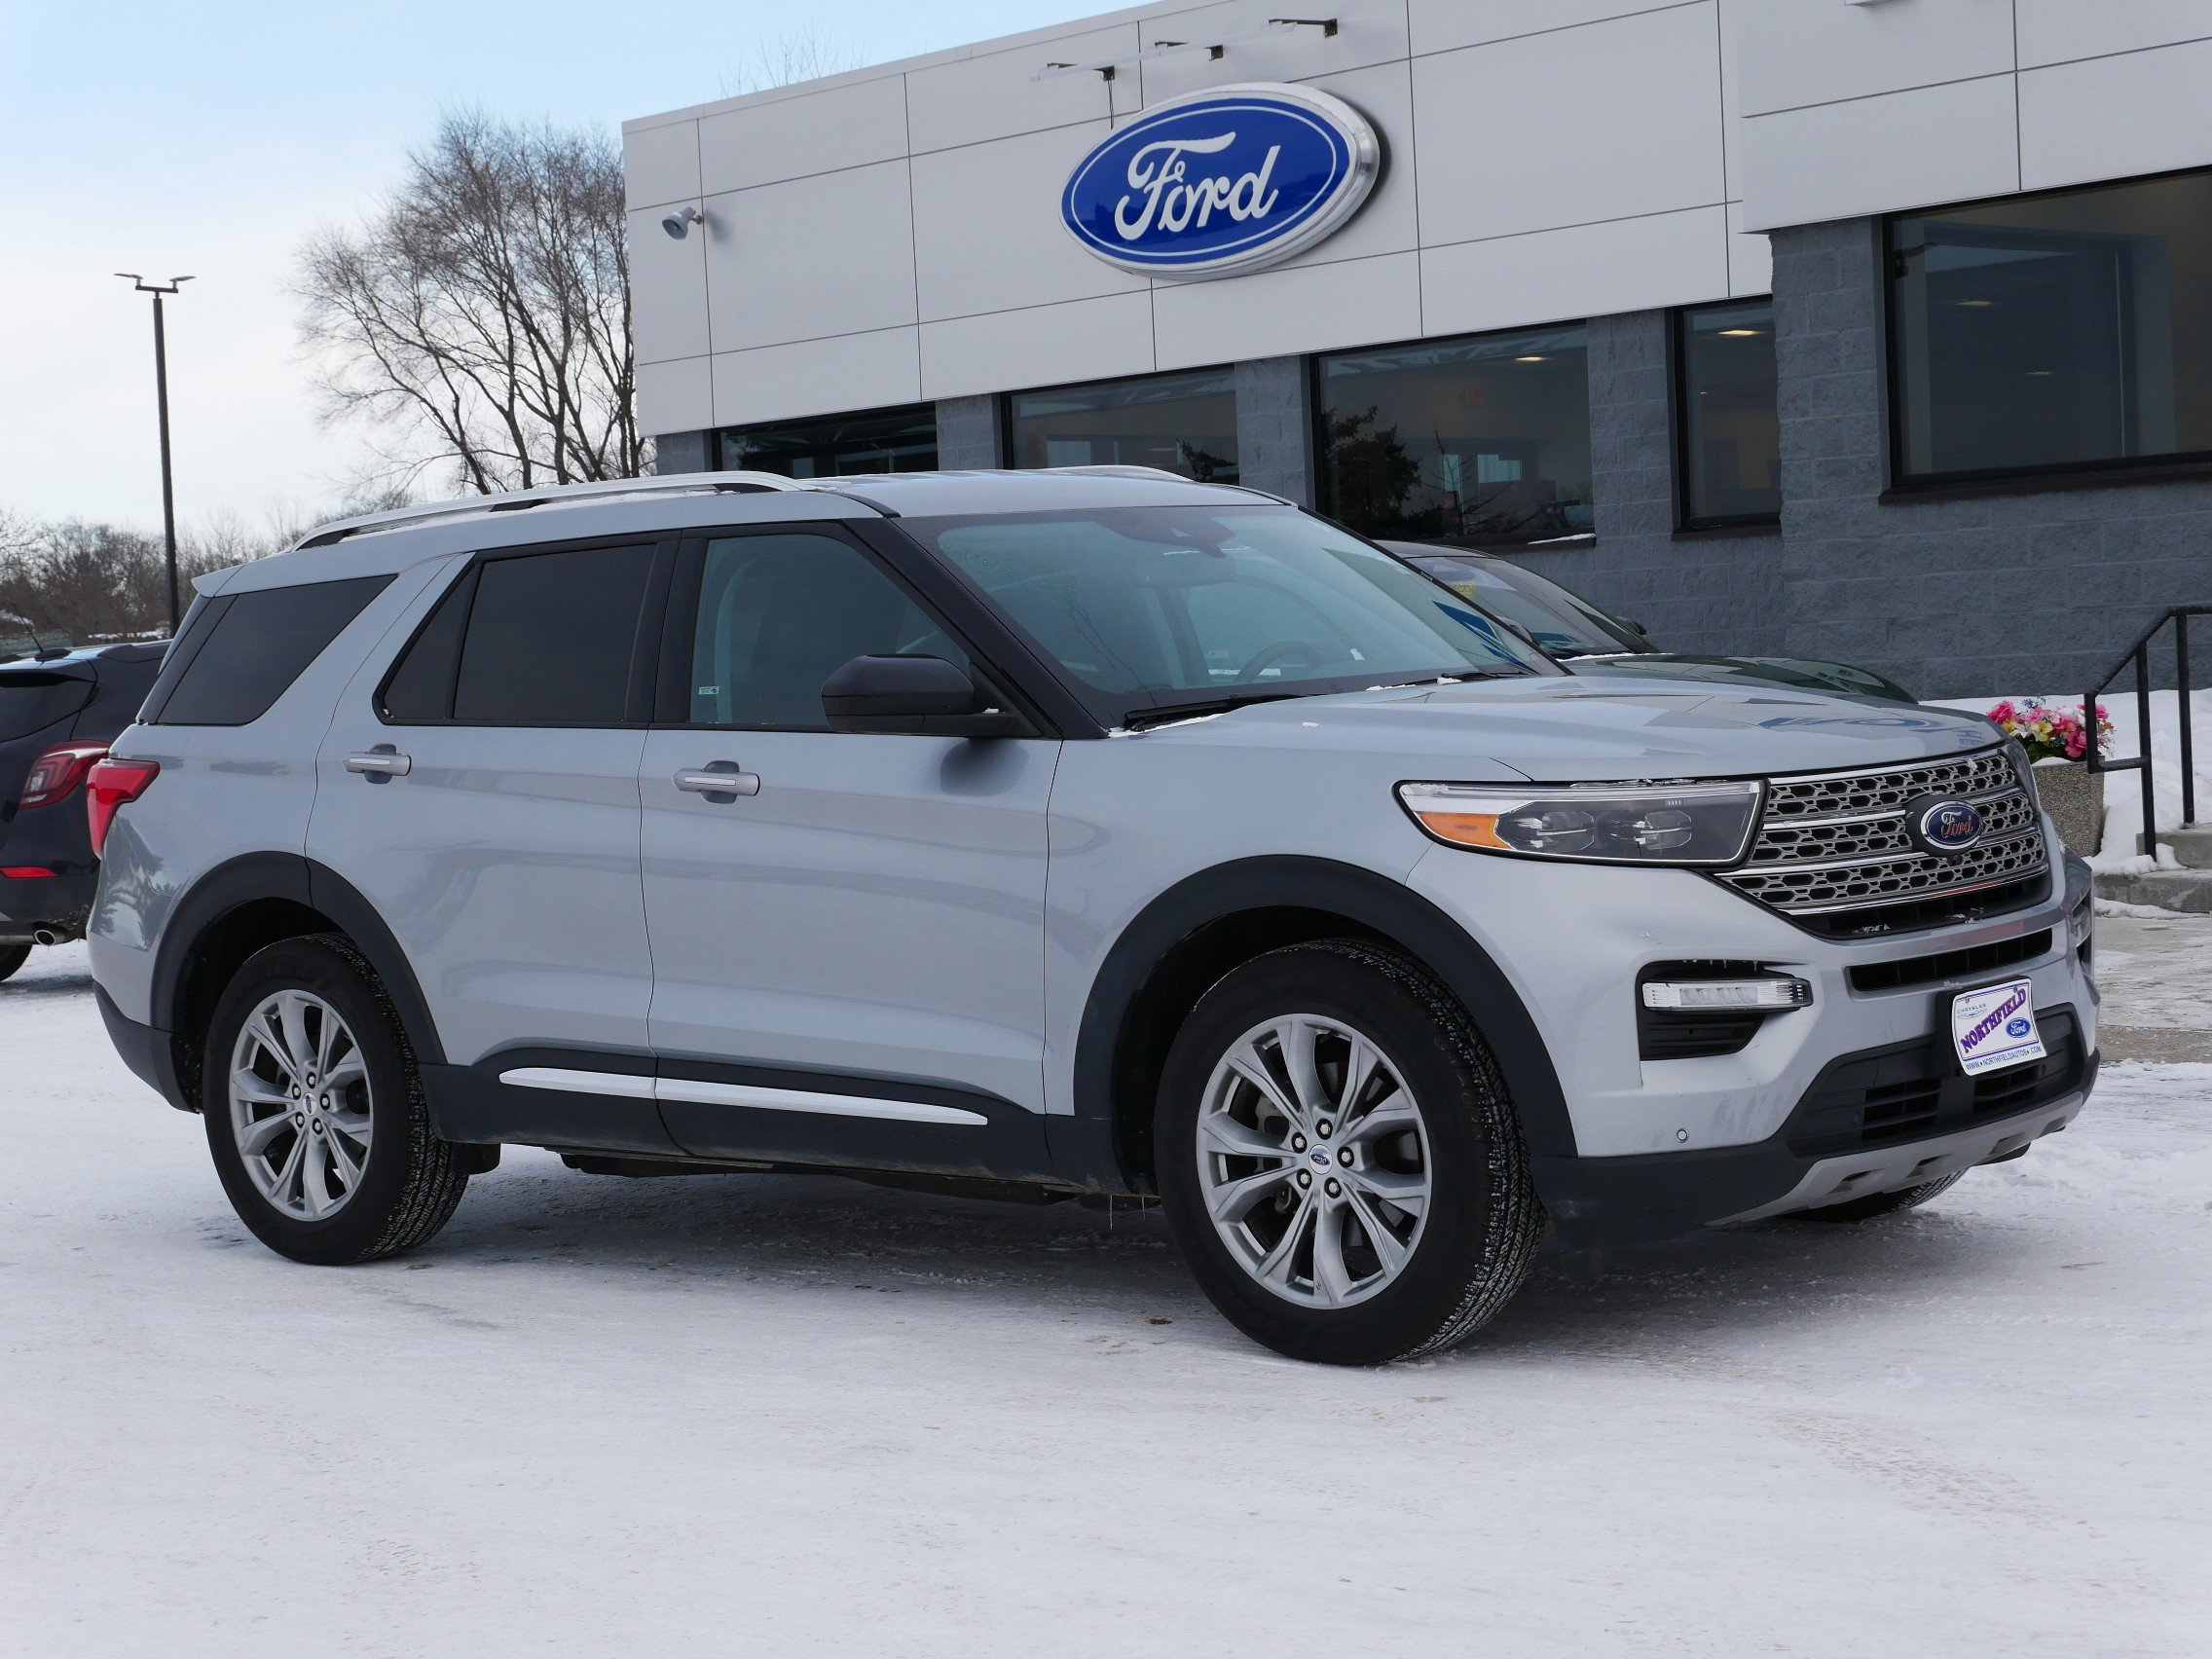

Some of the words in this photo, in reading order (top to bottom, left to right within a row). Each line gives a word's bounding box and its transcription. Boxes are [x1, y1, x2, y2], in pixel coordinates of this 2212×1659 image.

[1115, 131, 1281, 240] Ford
[1940, 811, 1973, 838] Ford
[1957, 1004, 1987, 1014] CHRYSLER
[1960, 988, 2027, 1053] NORTHFIELD
[2009, 1020, 2026, 1036] Ford
